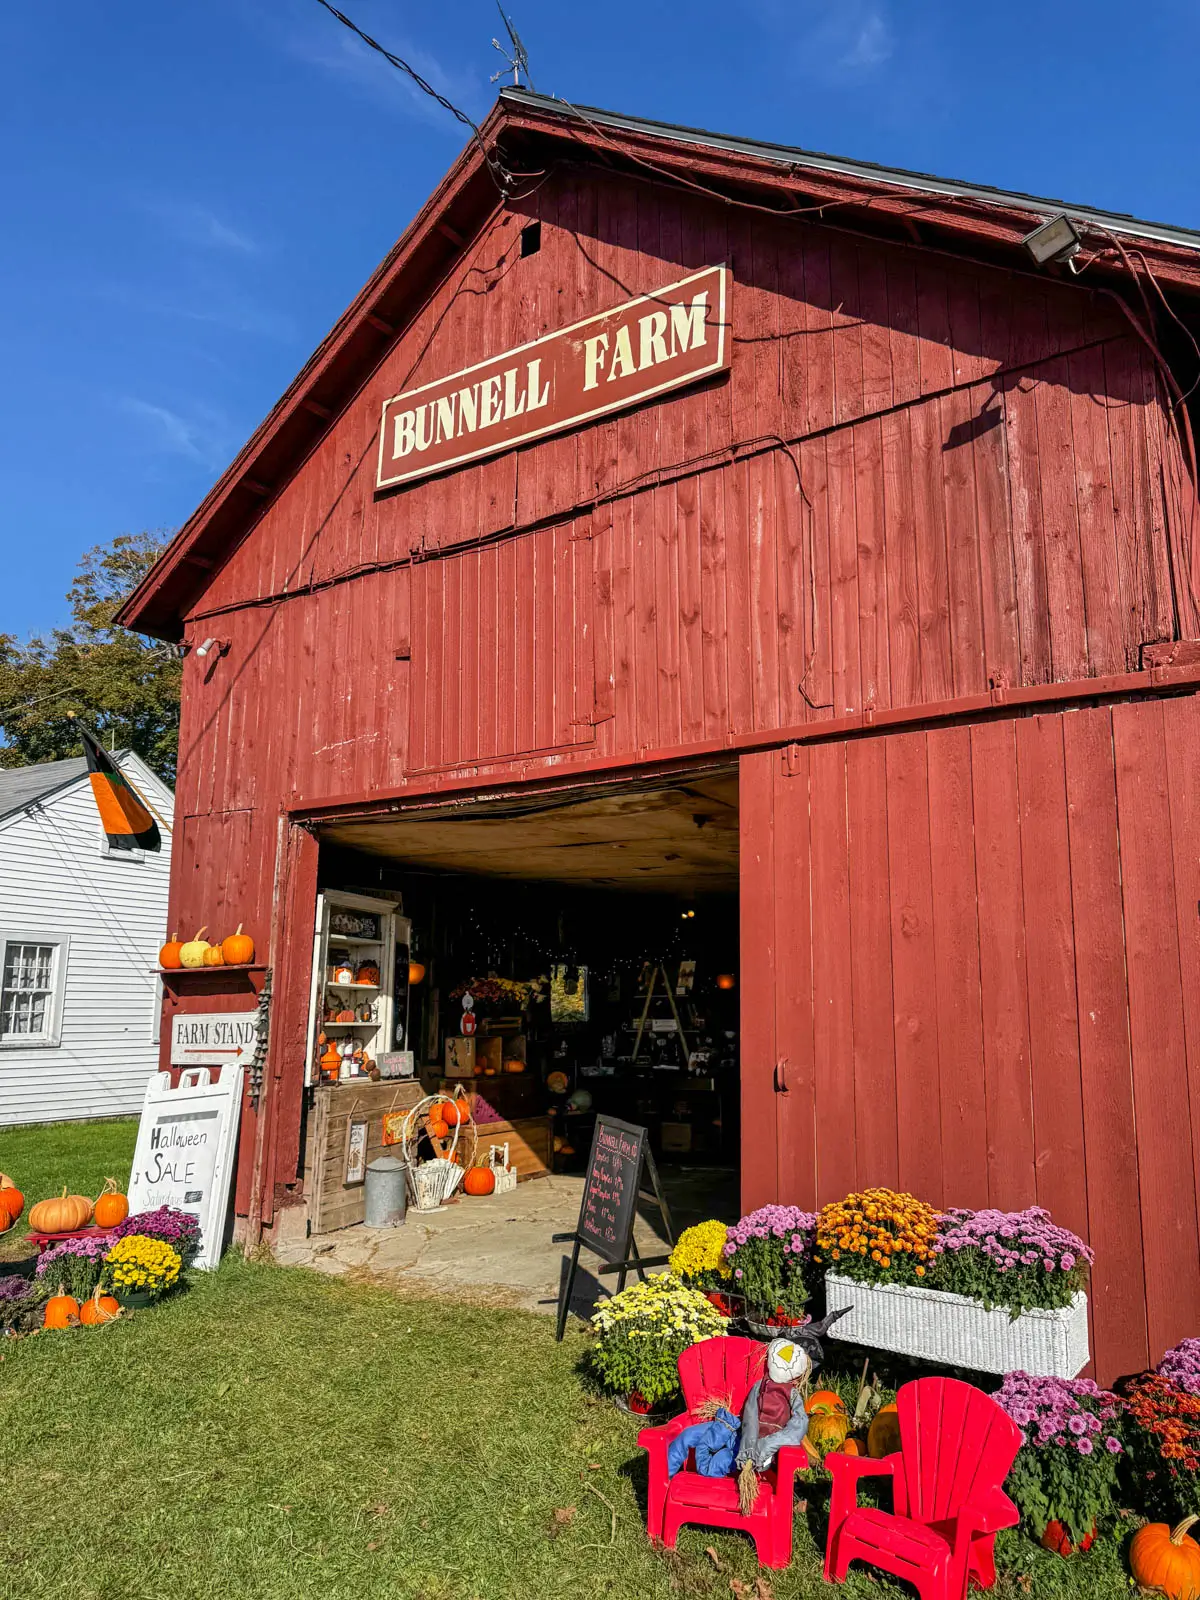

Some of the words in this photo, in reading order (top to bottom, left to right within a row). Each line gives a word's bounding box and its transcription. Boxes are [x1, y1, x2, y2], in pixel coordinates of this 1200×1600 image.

[391, 358, 551, 461] BUNNELL
[582, 290, 709, 392] FARM
[176, 1023, 209, 1045] FARM
[213, 1021, 254, 1045] STAND
[150, 1125, 208, 1150] Halloween
[144, 1152, 196, 1184] SALE
